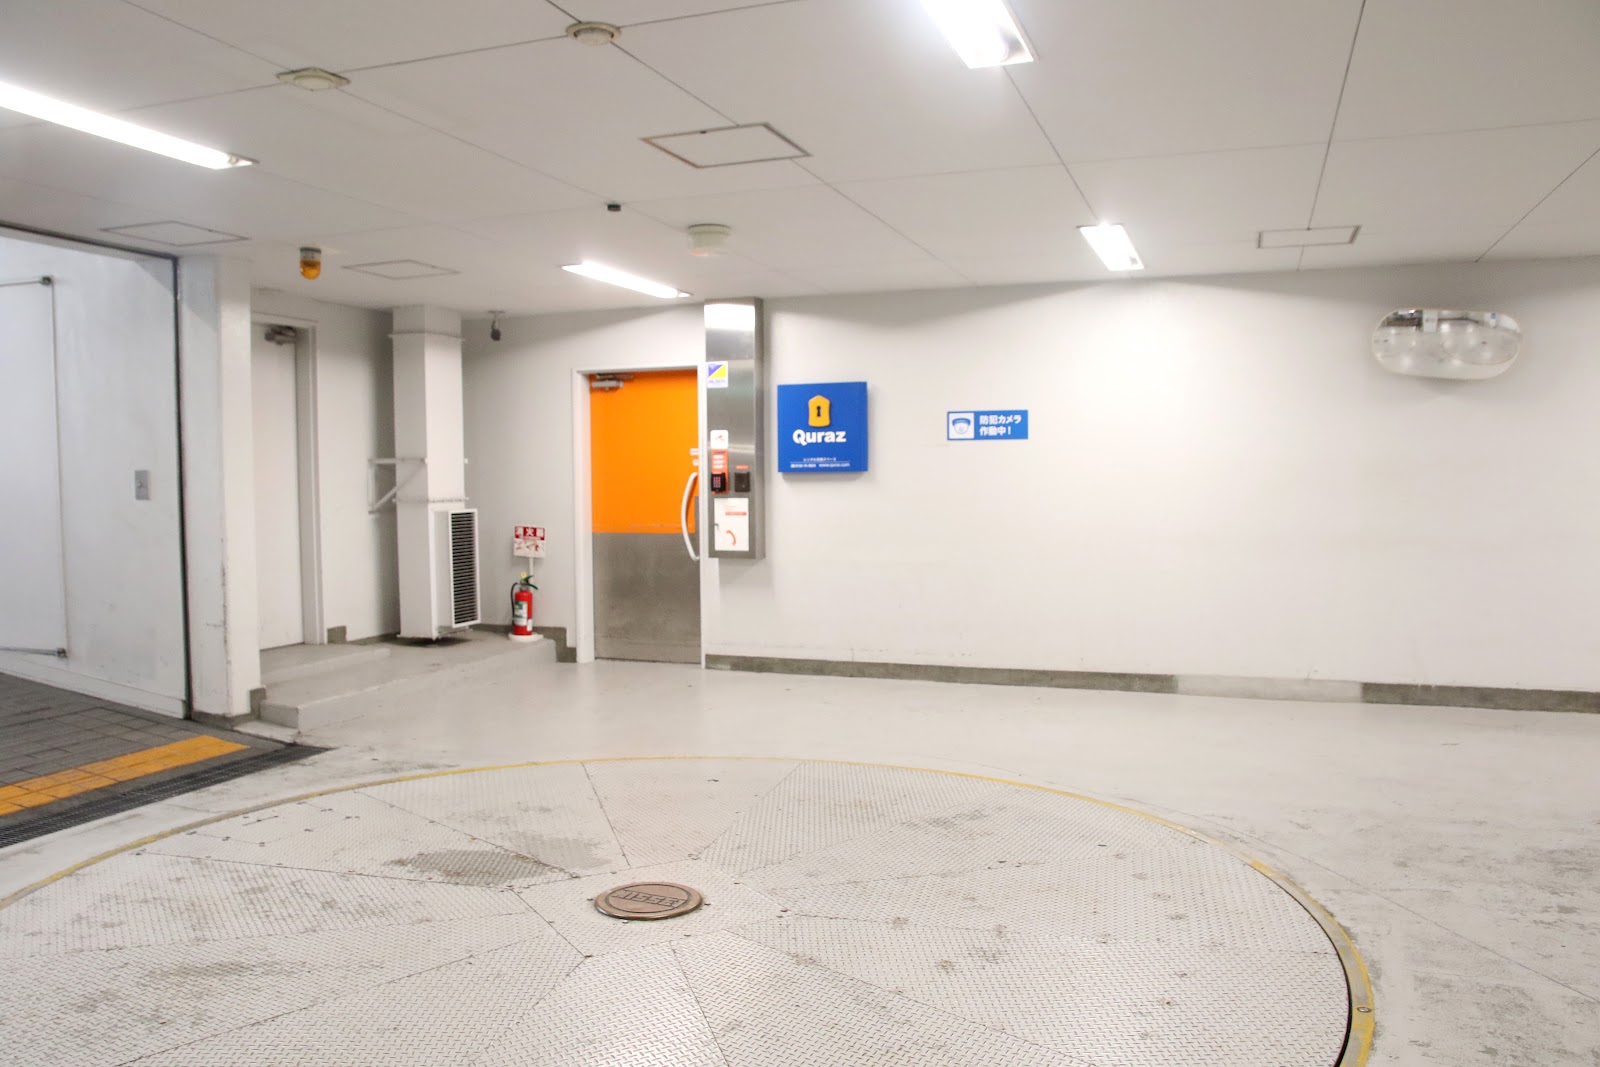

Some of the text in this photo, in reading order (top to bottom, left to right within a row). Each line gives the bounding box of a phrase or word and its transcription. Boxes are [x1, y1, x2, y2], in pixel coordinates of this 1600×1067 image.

[979, 414, 1022, 425] 防犯カメラ
[792, 429, 847, 446] Quraz
